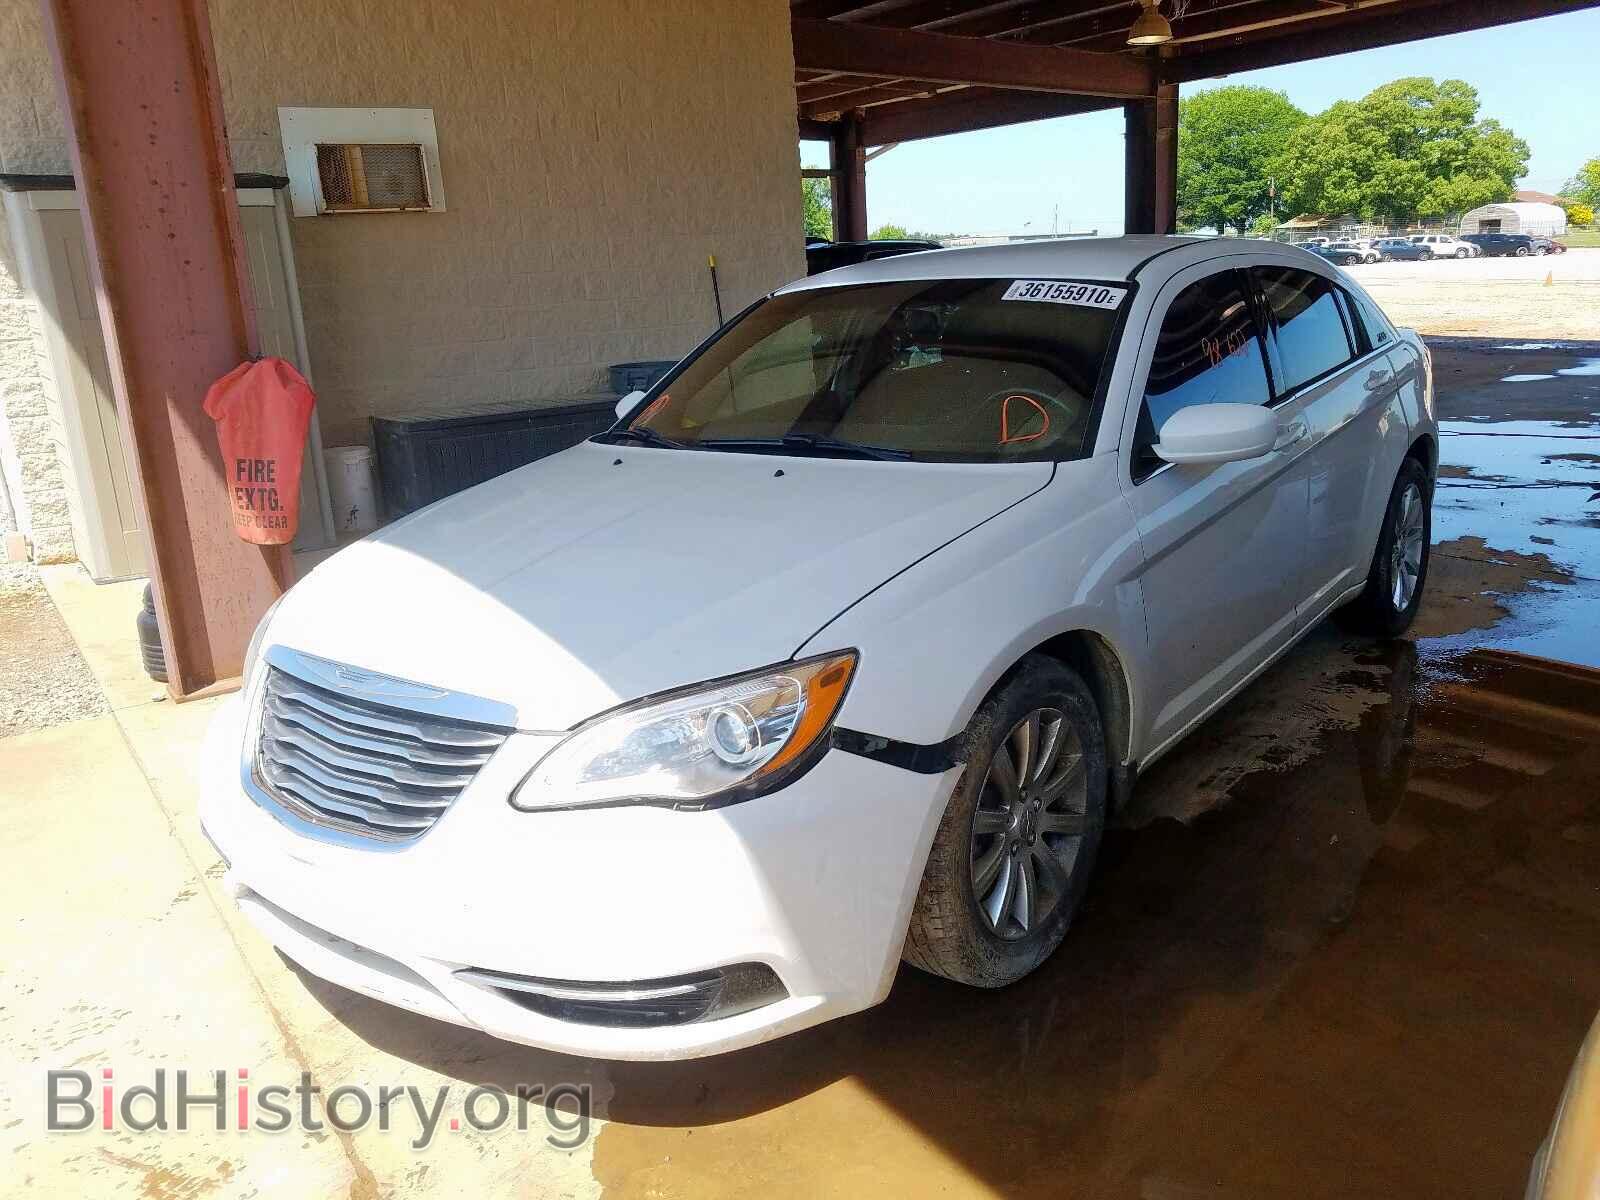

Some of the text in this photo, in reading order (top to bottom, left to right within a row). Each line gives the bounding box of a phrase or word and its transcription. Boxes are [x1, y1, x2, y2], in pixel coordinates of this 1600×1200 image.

[236, 458, 276, 483] FIRE
[235, 487, 284, 512] EXTG.
[256, 515, 288, 529] CLEAR
